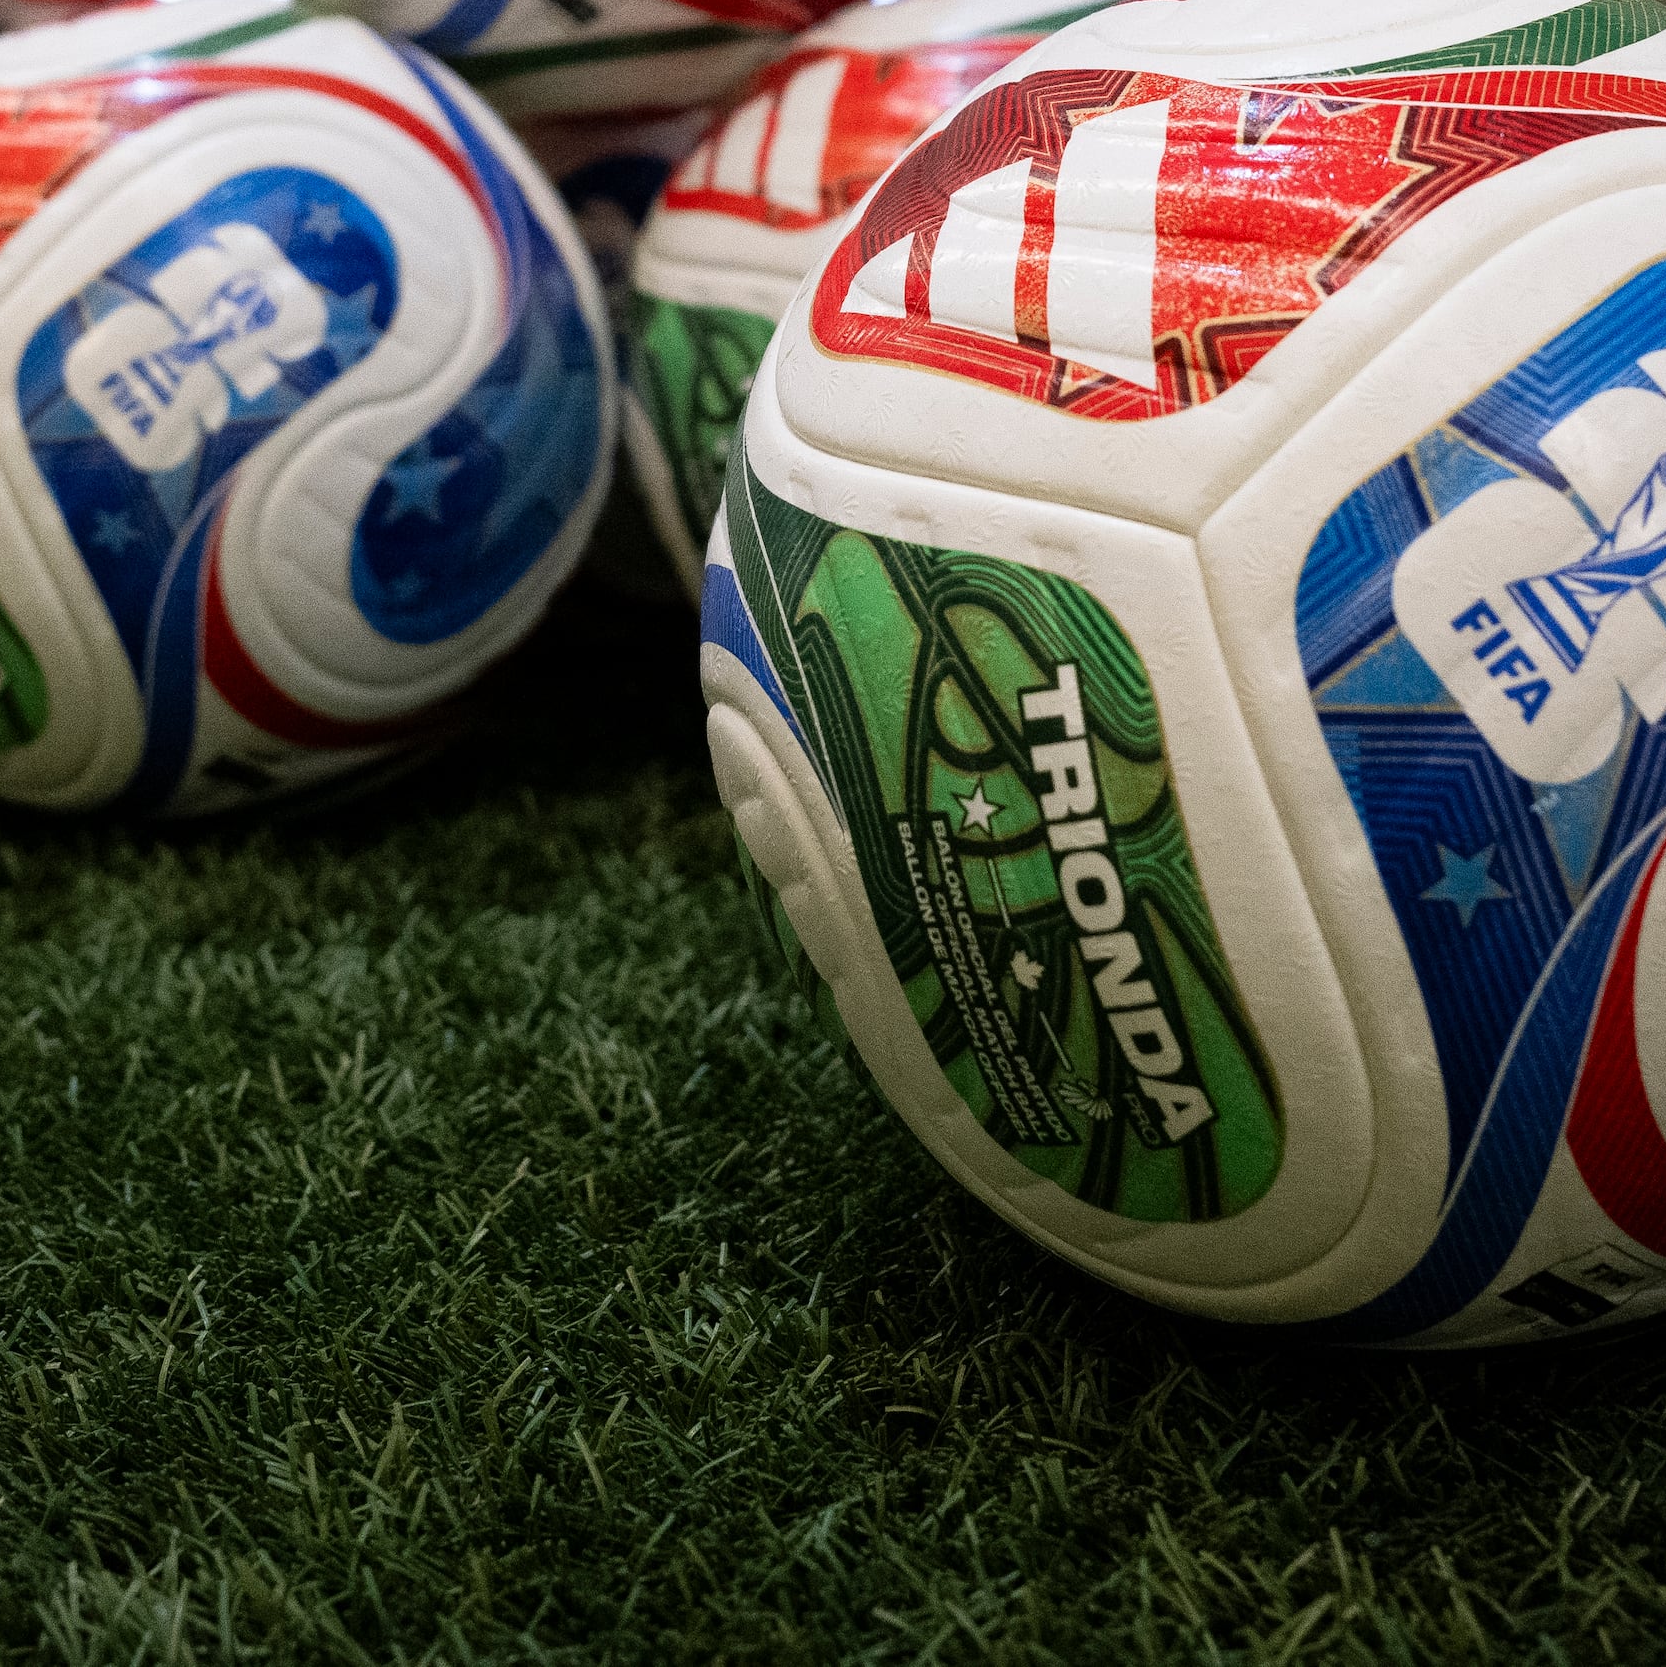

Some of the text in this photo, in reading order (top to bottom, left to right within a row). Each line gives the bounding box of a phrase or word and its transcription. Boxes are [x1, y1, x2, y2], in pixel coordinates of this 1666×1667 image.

[1450, 598, 1555, 725] FIFA
[897, 820, 936, 924] BALLON
[927, 926, 949, 959] DE
[940, 961, 984, 1049] MATCH
[934, 890, 979, 1004] OFFICIAL
[973, 1005, 1018, 1088] MATCH
[1022, 663, 1215, 1142] TRIONDA
[958, 911, 998, 1007] OFICIAL
[993, 1009, 1019, 1053] DEL
[1015, 1054, 1073, 1144] PARTIDO
